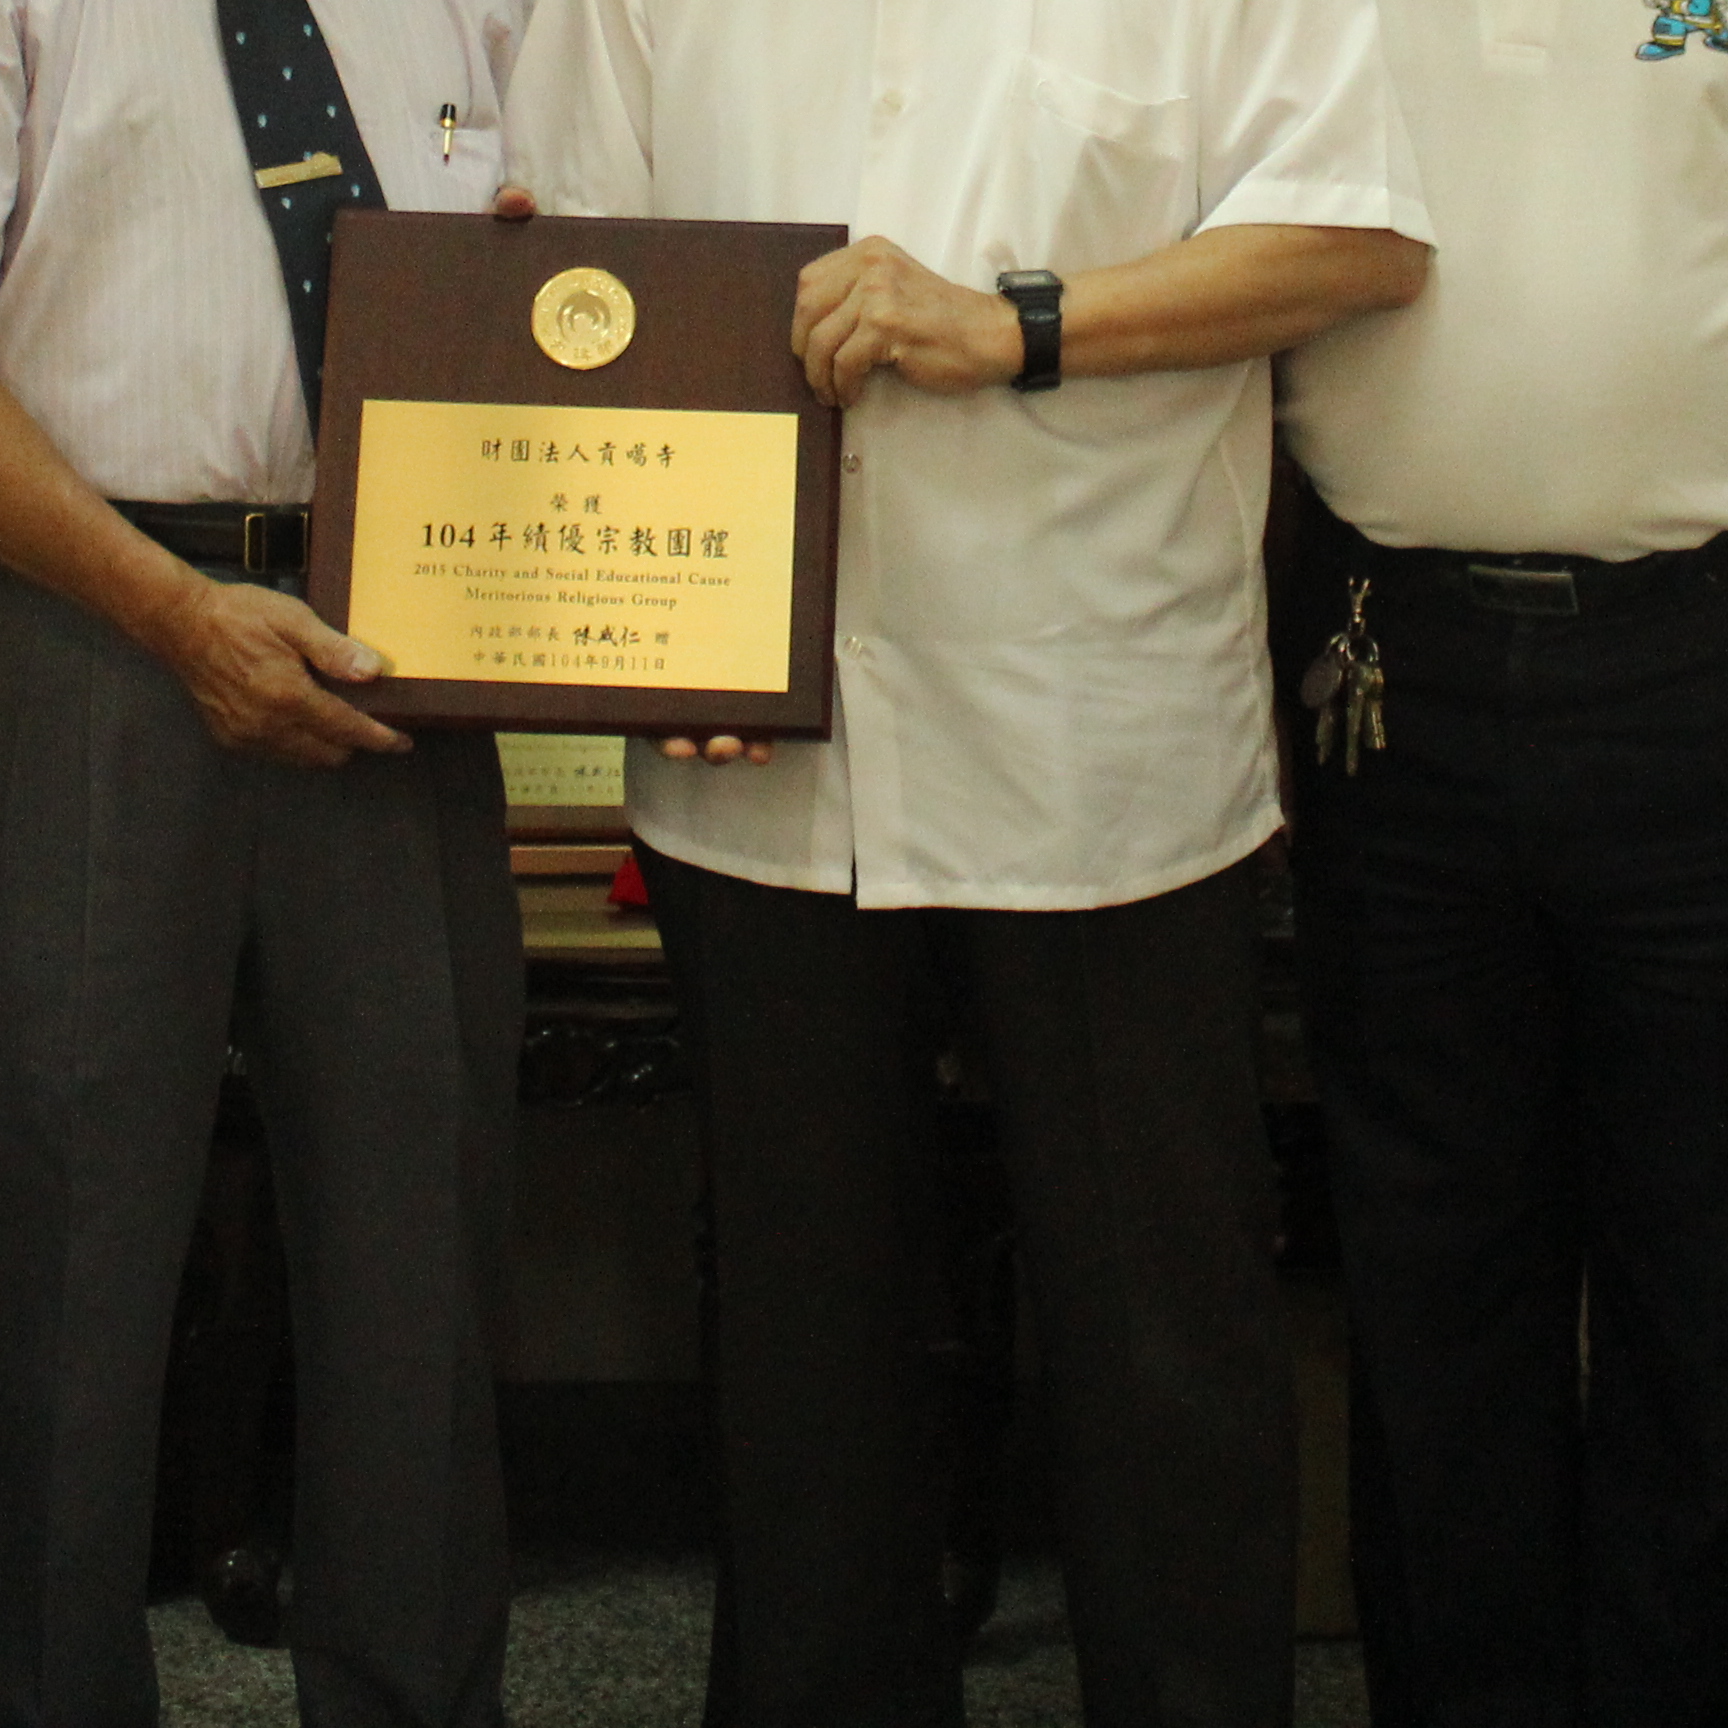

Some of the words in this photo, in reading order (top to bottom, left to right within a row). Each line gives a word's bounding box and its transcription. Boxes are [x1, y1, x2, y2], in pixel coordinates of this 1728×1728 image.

[481, 438, 676, 469] 財團法人貢噶寺
[549, 492, 603, 515] 榮獲
[414, 564, 447, 576] 2015
[453, 564, 506, 580] Charity
[514, 566, 538, 579] and
[545, 567, 589, 581] Social
[595, 569, 681, 585] Educational
[688, 573, 731, 587] Cause
[465, 586, 551, 603] Meritorious
[557, 590, 624, 608] Religious
[631, 593, 678, 611] Group
[573, 624, 641, 647] 陳威仁
